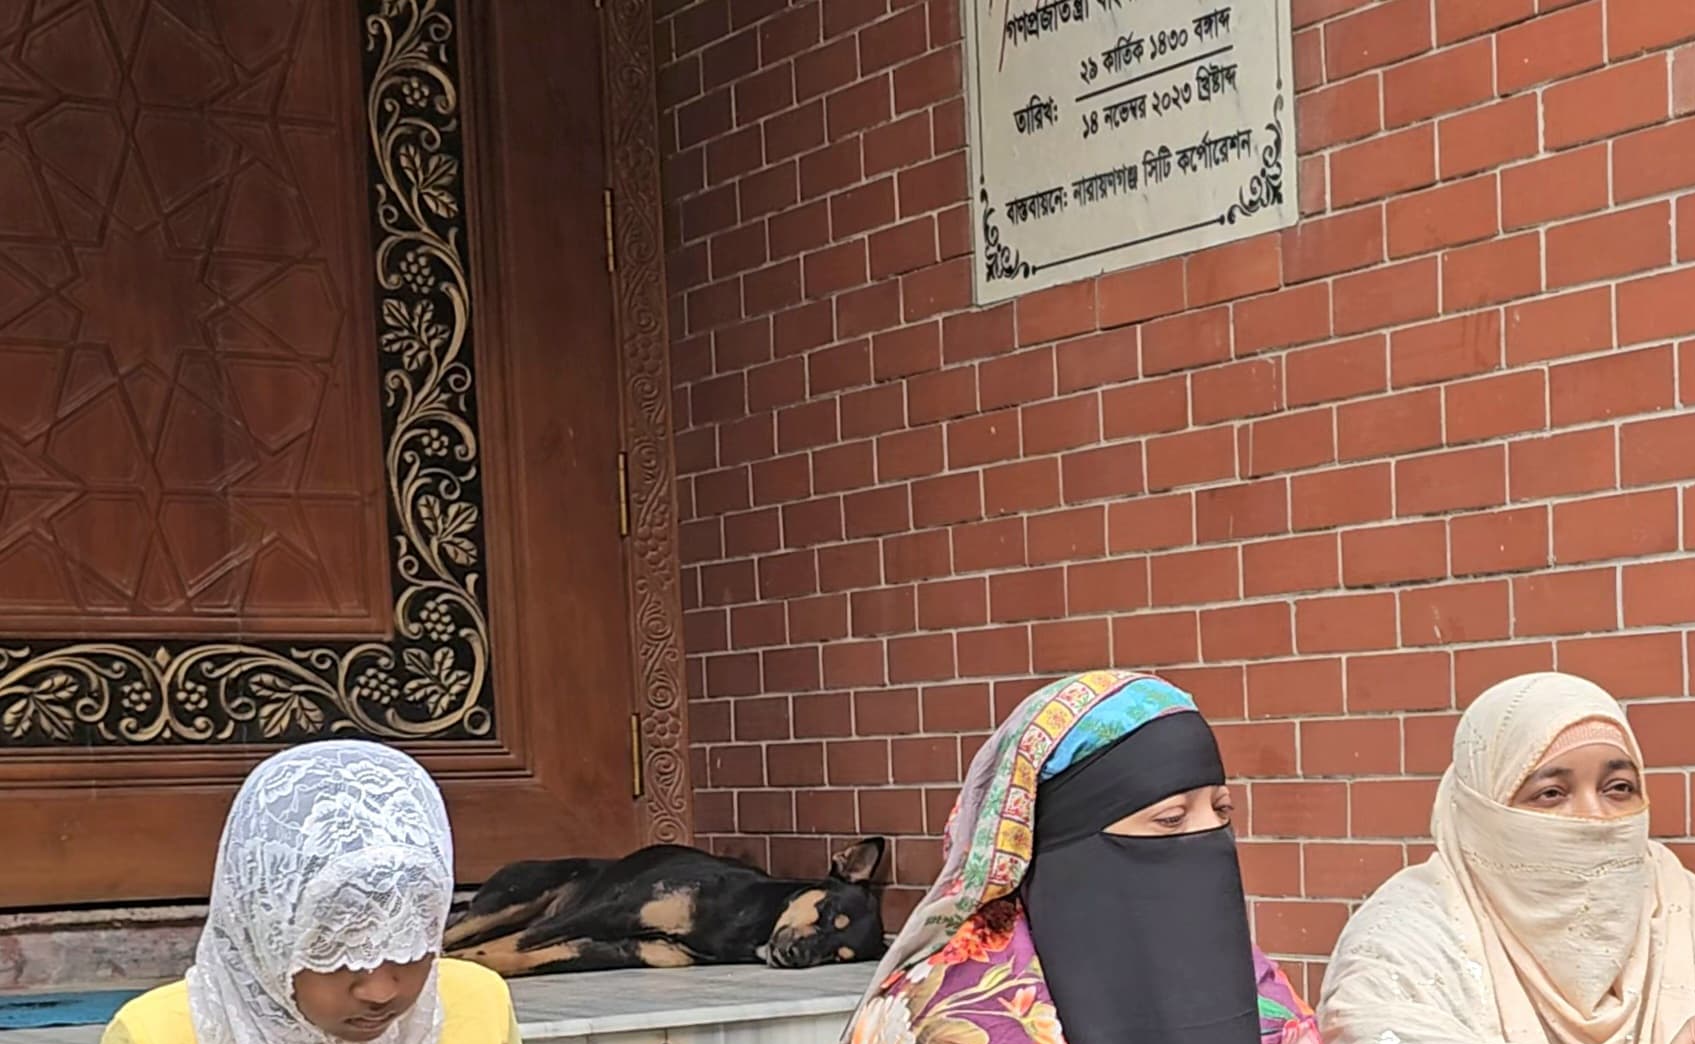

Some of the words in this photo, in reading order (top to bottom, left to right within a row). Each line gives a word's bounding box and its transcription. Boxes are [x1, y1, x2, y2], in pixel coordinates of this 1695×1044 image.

[1080, 57, 1098, 84] ২৯
[1101, 32, 1144, 73] কার্তিক
[1150, 29, 1188, 60] ১৪৩০
[1192, 7, 1231, 42] বঙ্গাব্দ
[1013, 95, 1058, 136] তারিখ:
[1082, 111, 1098, 139] ১৪
[1103, 94, 1147, 131] নভেম্বর
[1151, 81, 1192, 117] ২০২৩
[1005, 186, 1068, 226] বাস্তবায়নে:
[1072, 164, 1138, 206] নারায়ণগঞ্জ
[1142, 145, 1172, 186] সিটি
[1175, 130, 1252, 175] কর্পোরেশন
